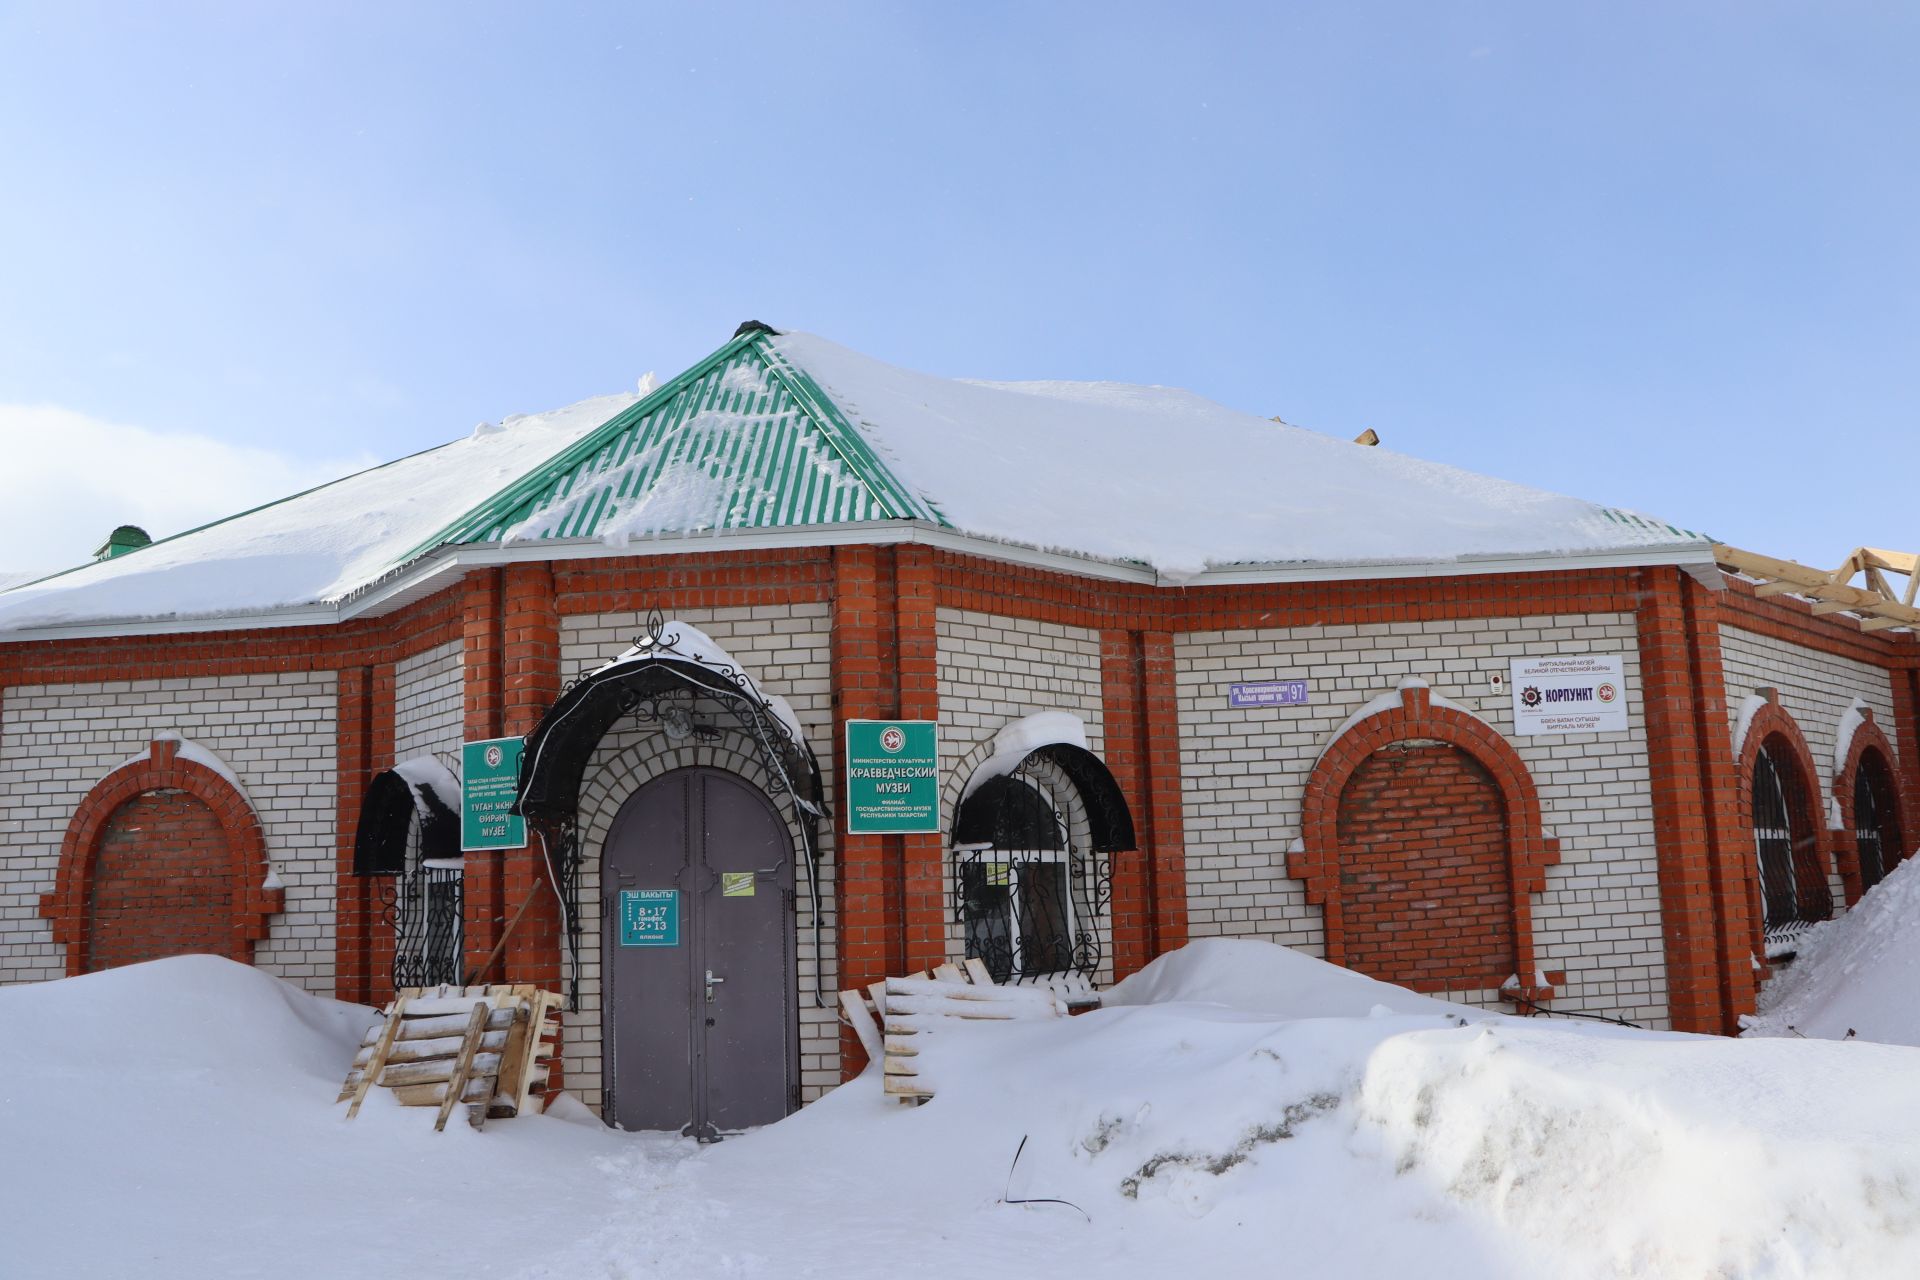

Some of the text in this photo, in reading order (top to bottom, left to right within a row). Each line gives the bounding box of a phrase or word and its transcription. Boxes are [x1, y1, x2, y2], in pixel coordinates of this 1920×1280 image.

[1291, 684, 1303, 700] 97
[1545, 687, 1593, 702] КОРПУНКТ
[482, 825, 506, 836] МУЗЕЕ
[626, 891, 673, 899] ЭШ ВАКЫТЫ
